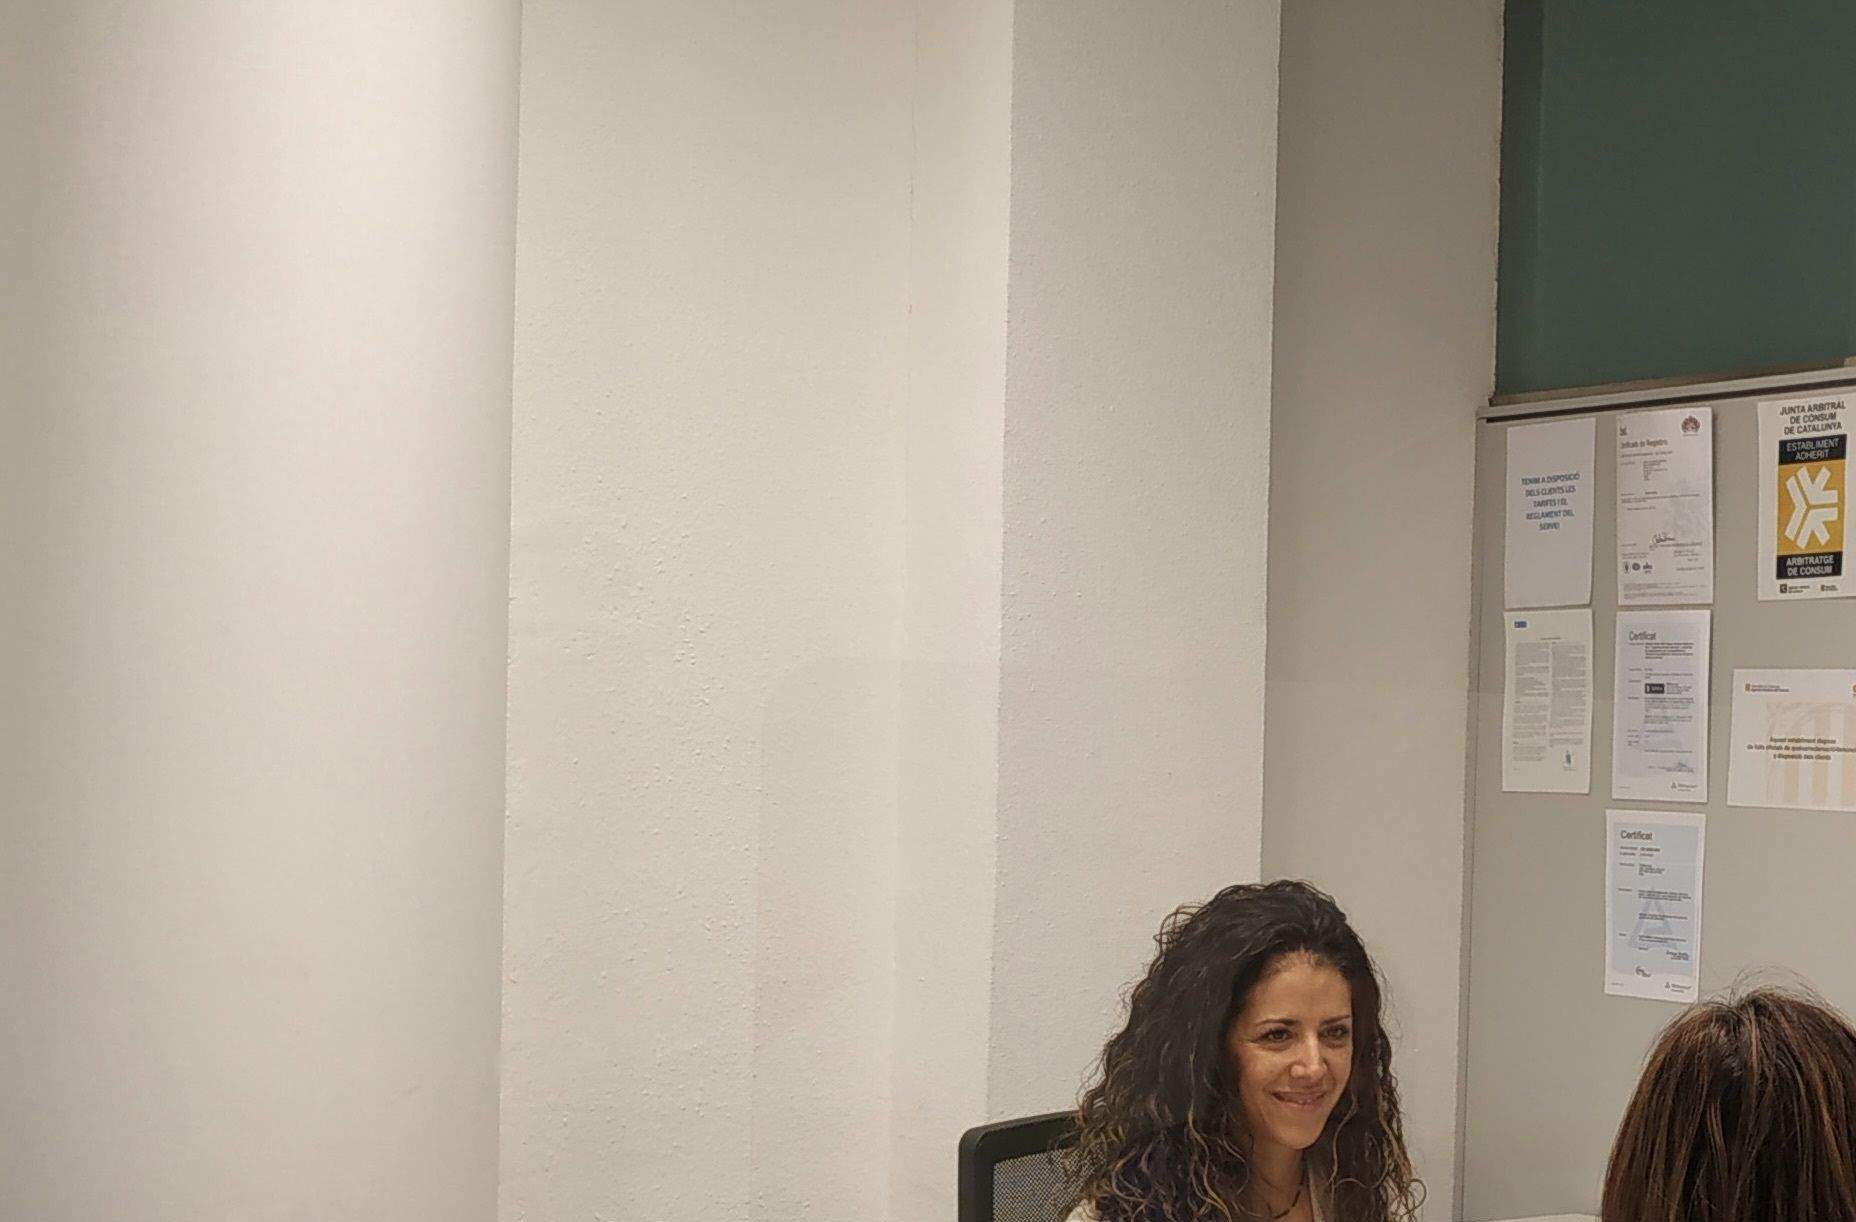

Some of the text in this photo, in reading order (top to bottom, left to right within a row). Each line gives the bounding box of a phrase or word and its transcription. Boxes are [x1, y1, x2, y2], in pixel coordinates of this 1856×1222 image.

[1780, 401, 1846, 416] JUNTA ARBITRAL
[1790, 412, 1837, 424] DE CONSUM
[1784, 422, 1842, 435] DE CATALUNYA
[1786, 438, 1840, 452] ESTABLIMENT
[1786, 555, 1834, 566] ARBITRATGE
[1787, 566, 1833, 576] DE CONSUM
[1620, 830, 1653, 840] Certificat
